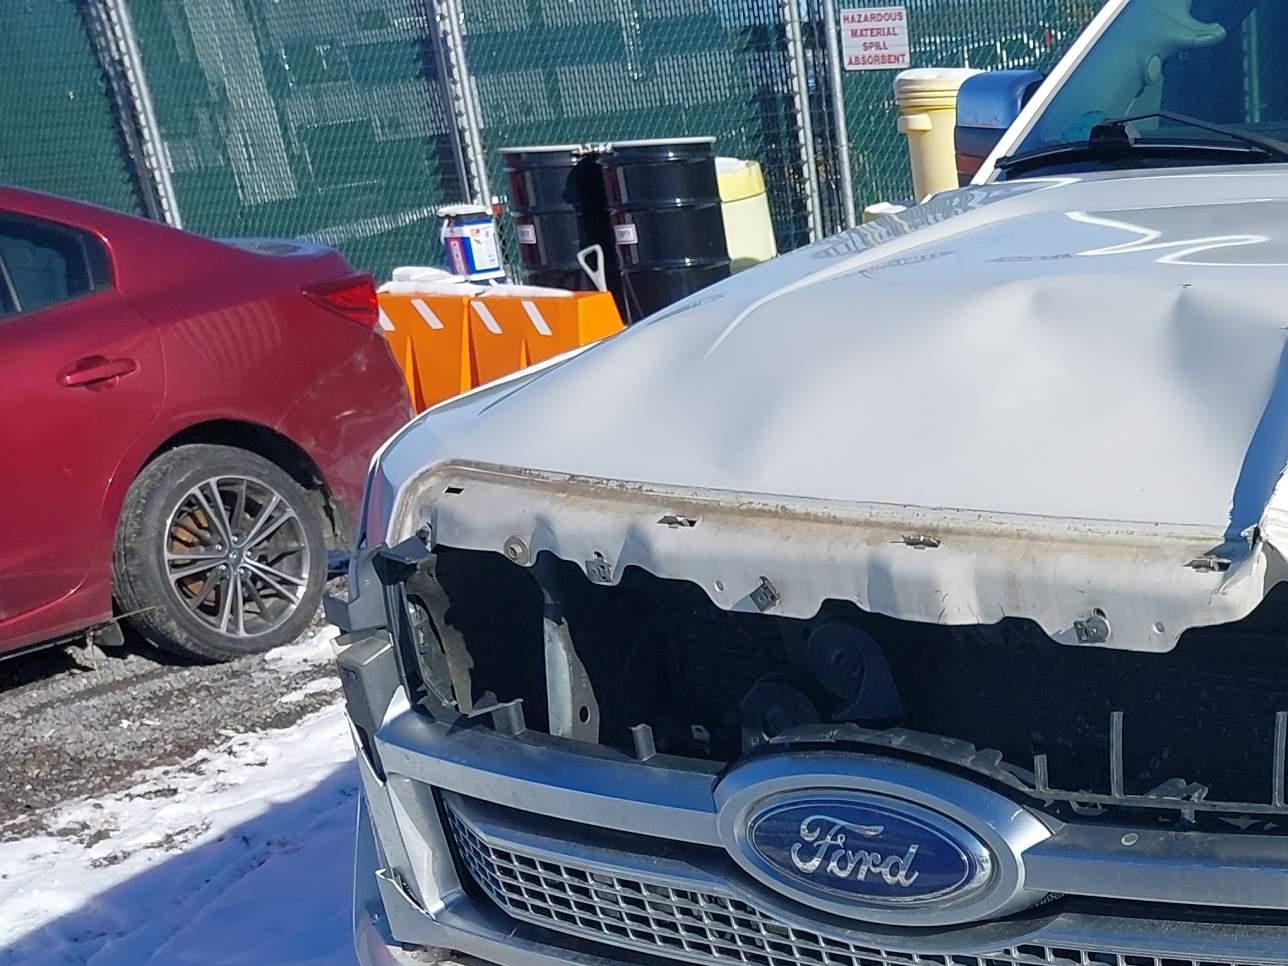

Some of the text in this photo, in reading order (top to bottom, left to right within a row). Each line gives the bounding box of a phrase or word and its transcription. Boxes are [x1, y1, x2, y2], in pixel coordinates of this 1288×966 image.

[843, 11, 904, 24] HAZARDOUS
[850, 27, 898, 38] MATERIAL
[862, 41, 889, 51] SPILL
[847, 54, 906, 66] ABSORBENT
[791, 814, 920, 888] Ford
